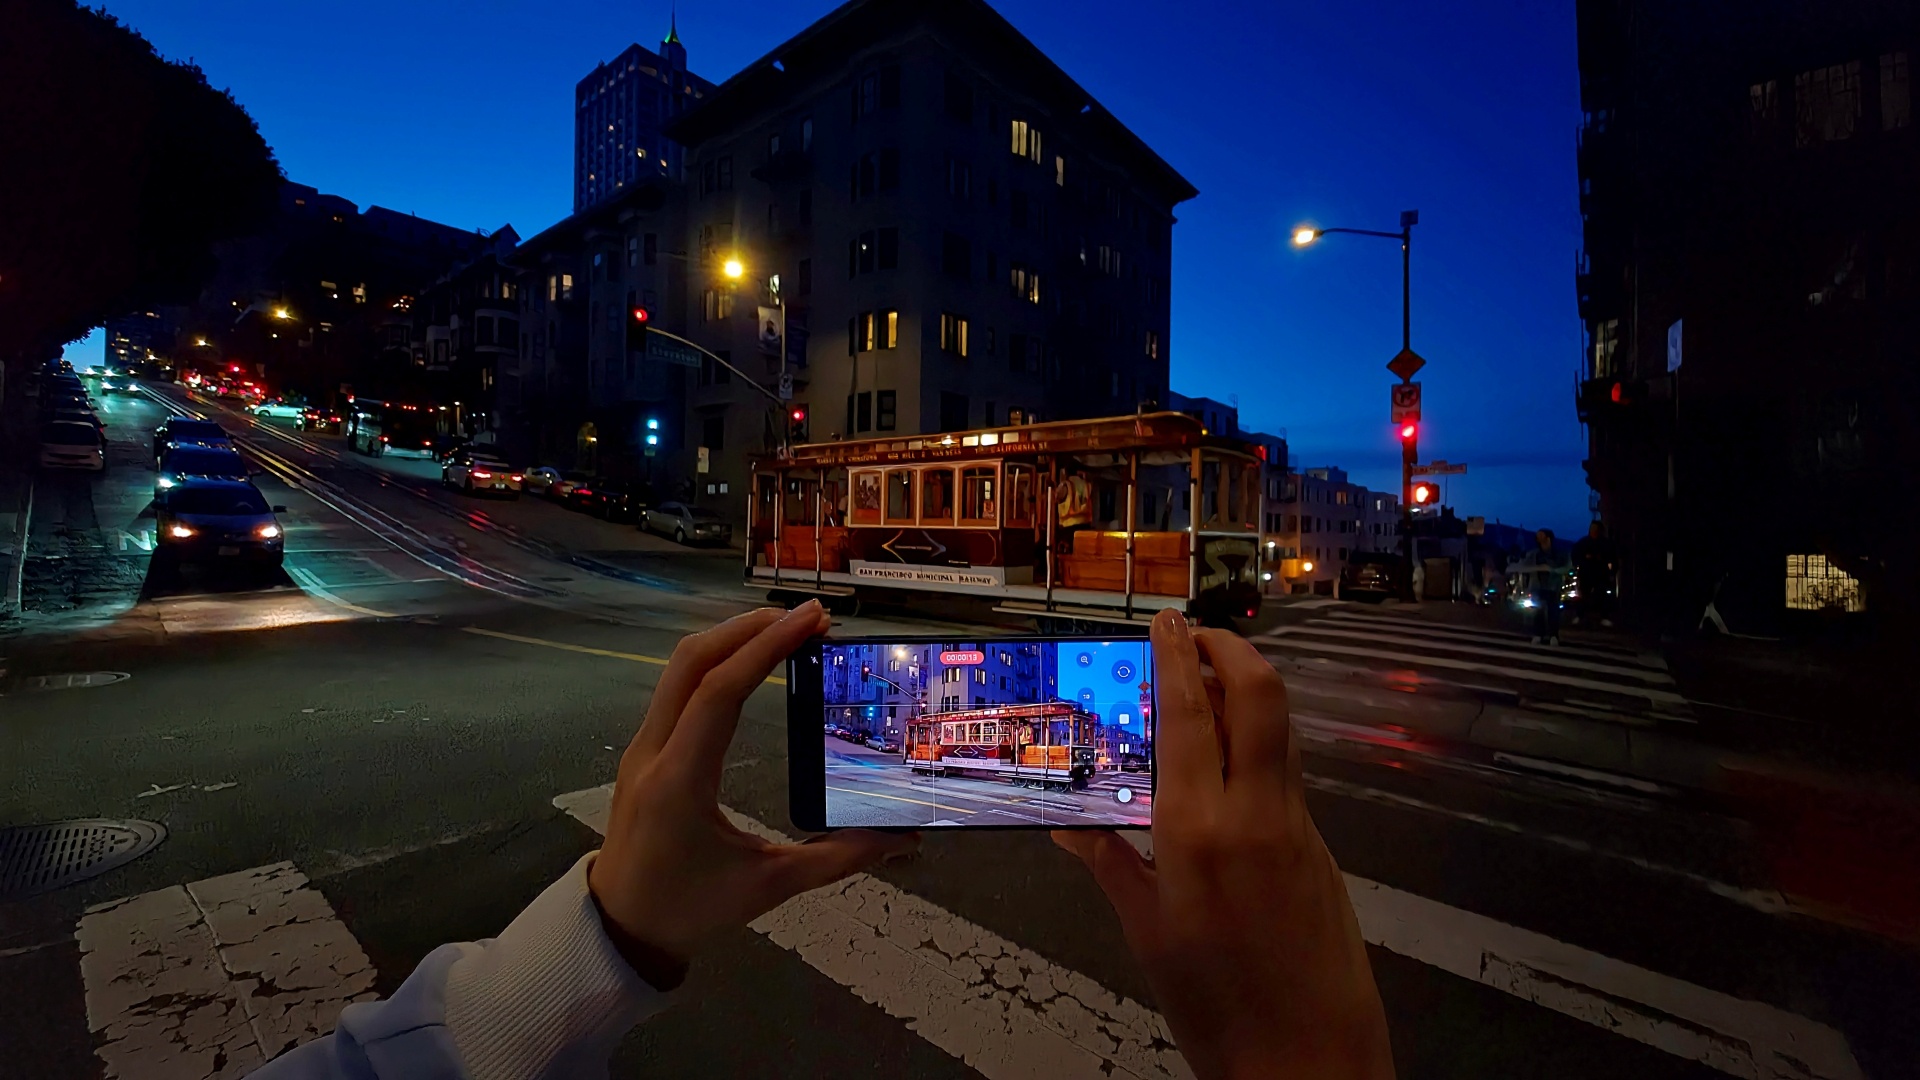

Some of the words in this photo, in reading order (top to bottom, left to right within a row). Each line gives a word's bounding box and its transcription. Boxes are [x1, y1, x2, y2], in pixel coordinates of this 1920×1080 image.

[990, 442, 1036, 453] CALIFORNIA
[874, 570, 913, 578] FRANCISCO
[916, 573, 954, 582] MUNICIPAL
[958, 575, 991, 584] RAILWAY
